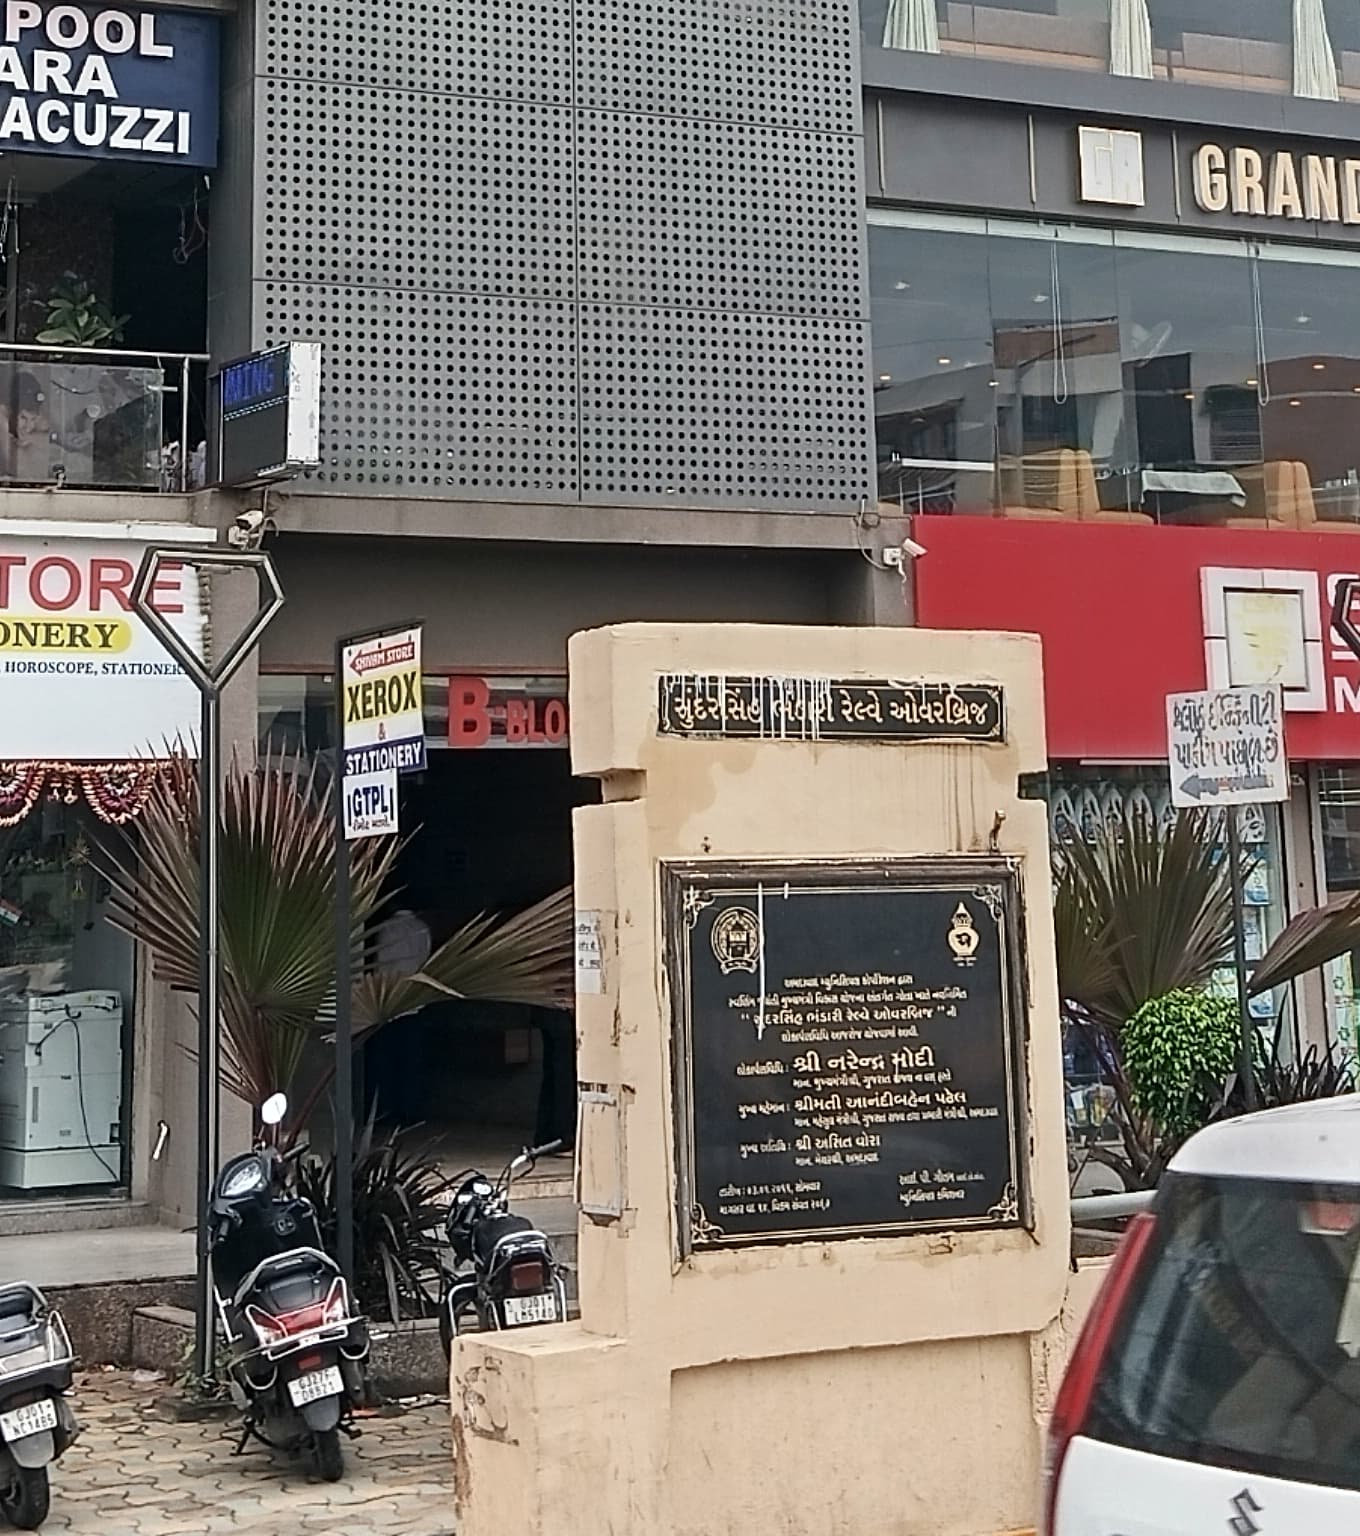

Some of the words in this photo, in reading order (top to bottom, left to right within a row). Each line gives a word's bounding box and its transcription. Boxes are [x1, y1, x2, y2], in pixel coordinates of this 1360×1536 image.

[5, 0, 173, 58] POOL
[386, 642, 414, 662] STORE
[347, 671, 418, 723] XEROX
[840, 689, 883, 724] રેલ્વે
[346, 742, 423, 776] STATIONERY
[352, 783, 389, 818] GTPL
